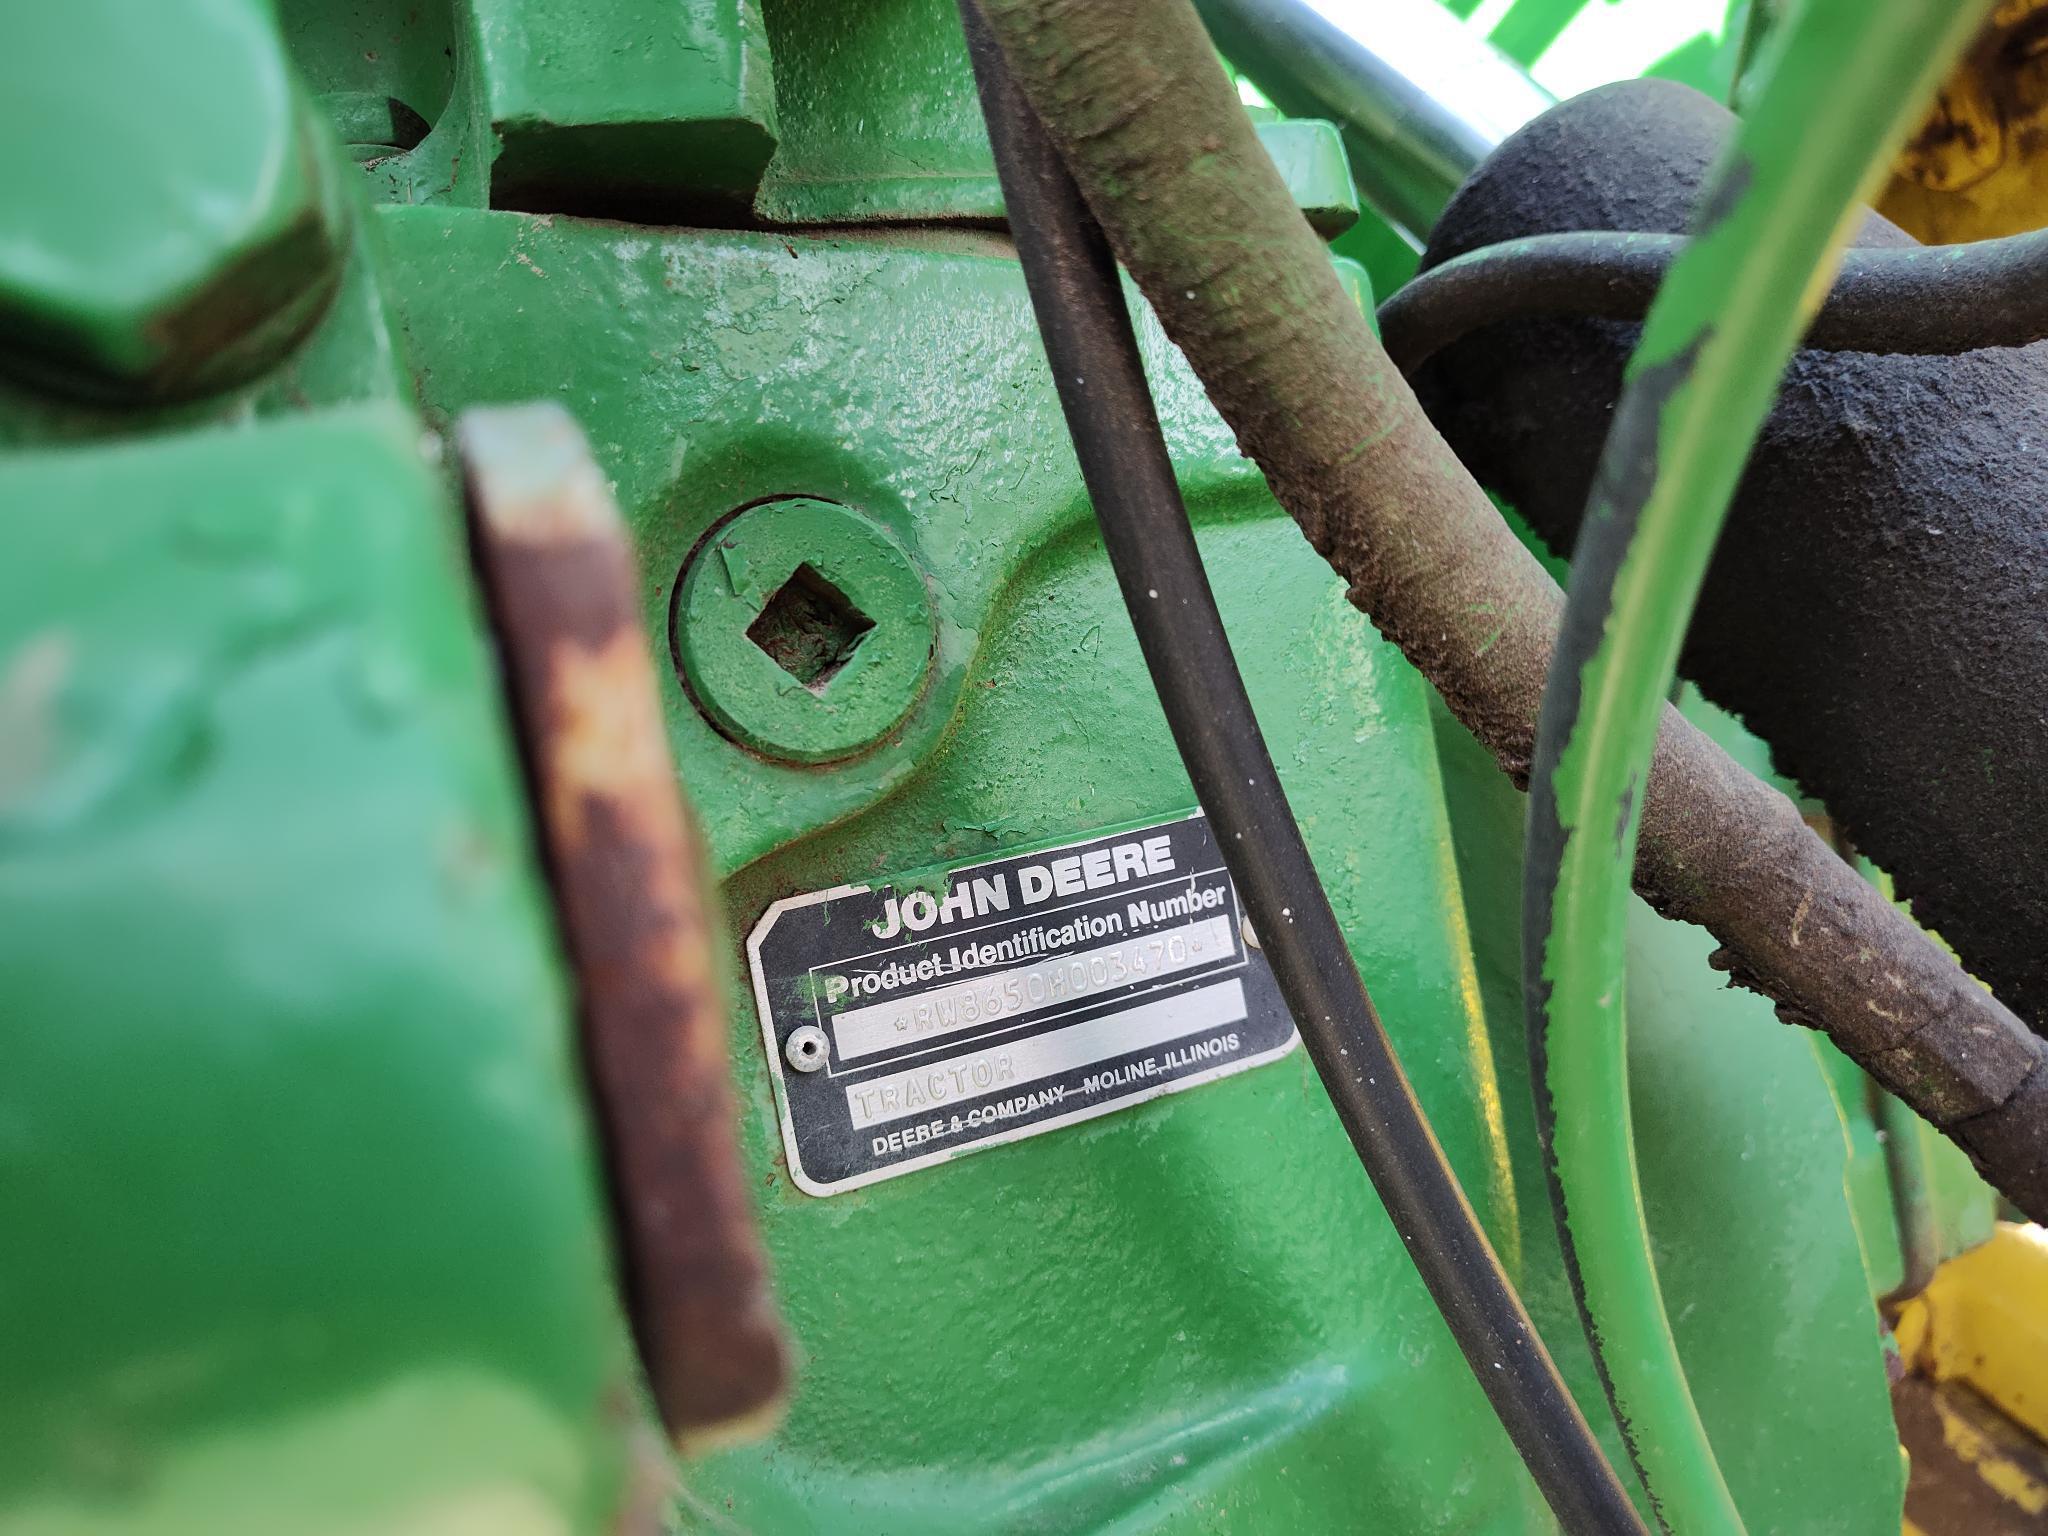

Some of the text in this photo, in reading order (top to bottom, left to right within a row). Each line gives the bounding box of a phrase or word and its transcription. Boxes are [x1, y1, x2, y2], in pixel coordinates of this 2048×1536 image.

[872, 835, 1175, 939] JOHN DEERE
[825, 885, 1226, 1003] Product Identification Number
[855, 1052, 1015, 1119] TRACTOR
[872, 1033, 1240, 1156] DEERE & COMPANY MOLINE, ILLINOIS
